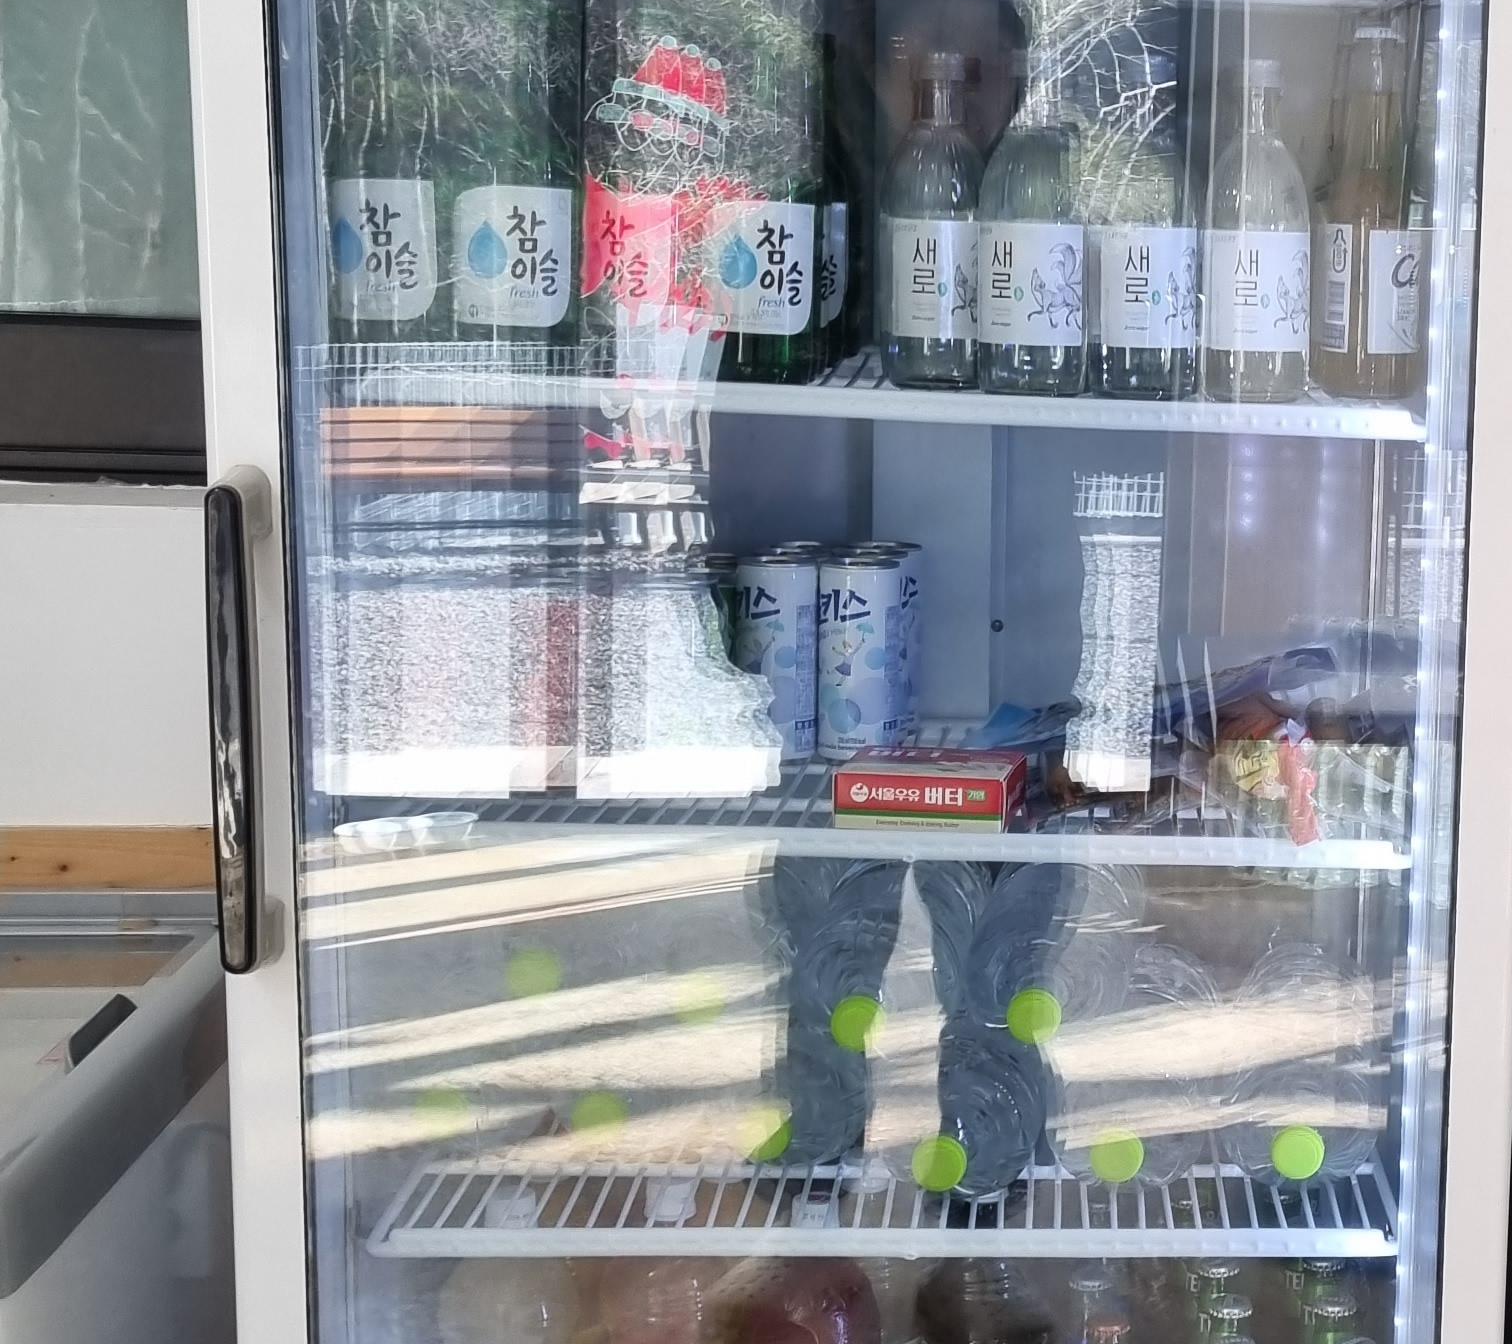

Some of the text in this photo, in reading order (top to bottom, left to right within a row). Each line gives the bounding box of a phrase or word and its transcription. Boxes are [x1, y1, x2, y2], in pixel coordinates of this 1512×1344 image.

[508, 285, 540, 299] fresh
[911, 237, 937, 295] 새로
[991, 240, 1013, 299] 새로
[1124, 245, 1151, 303] 새로
[1233, 249, 1259, 306] 새로
[758, 295, 786, 308] fresh
[869, 786, 920, 802] 서울우유
[924, 786, 963, 807] 버터
